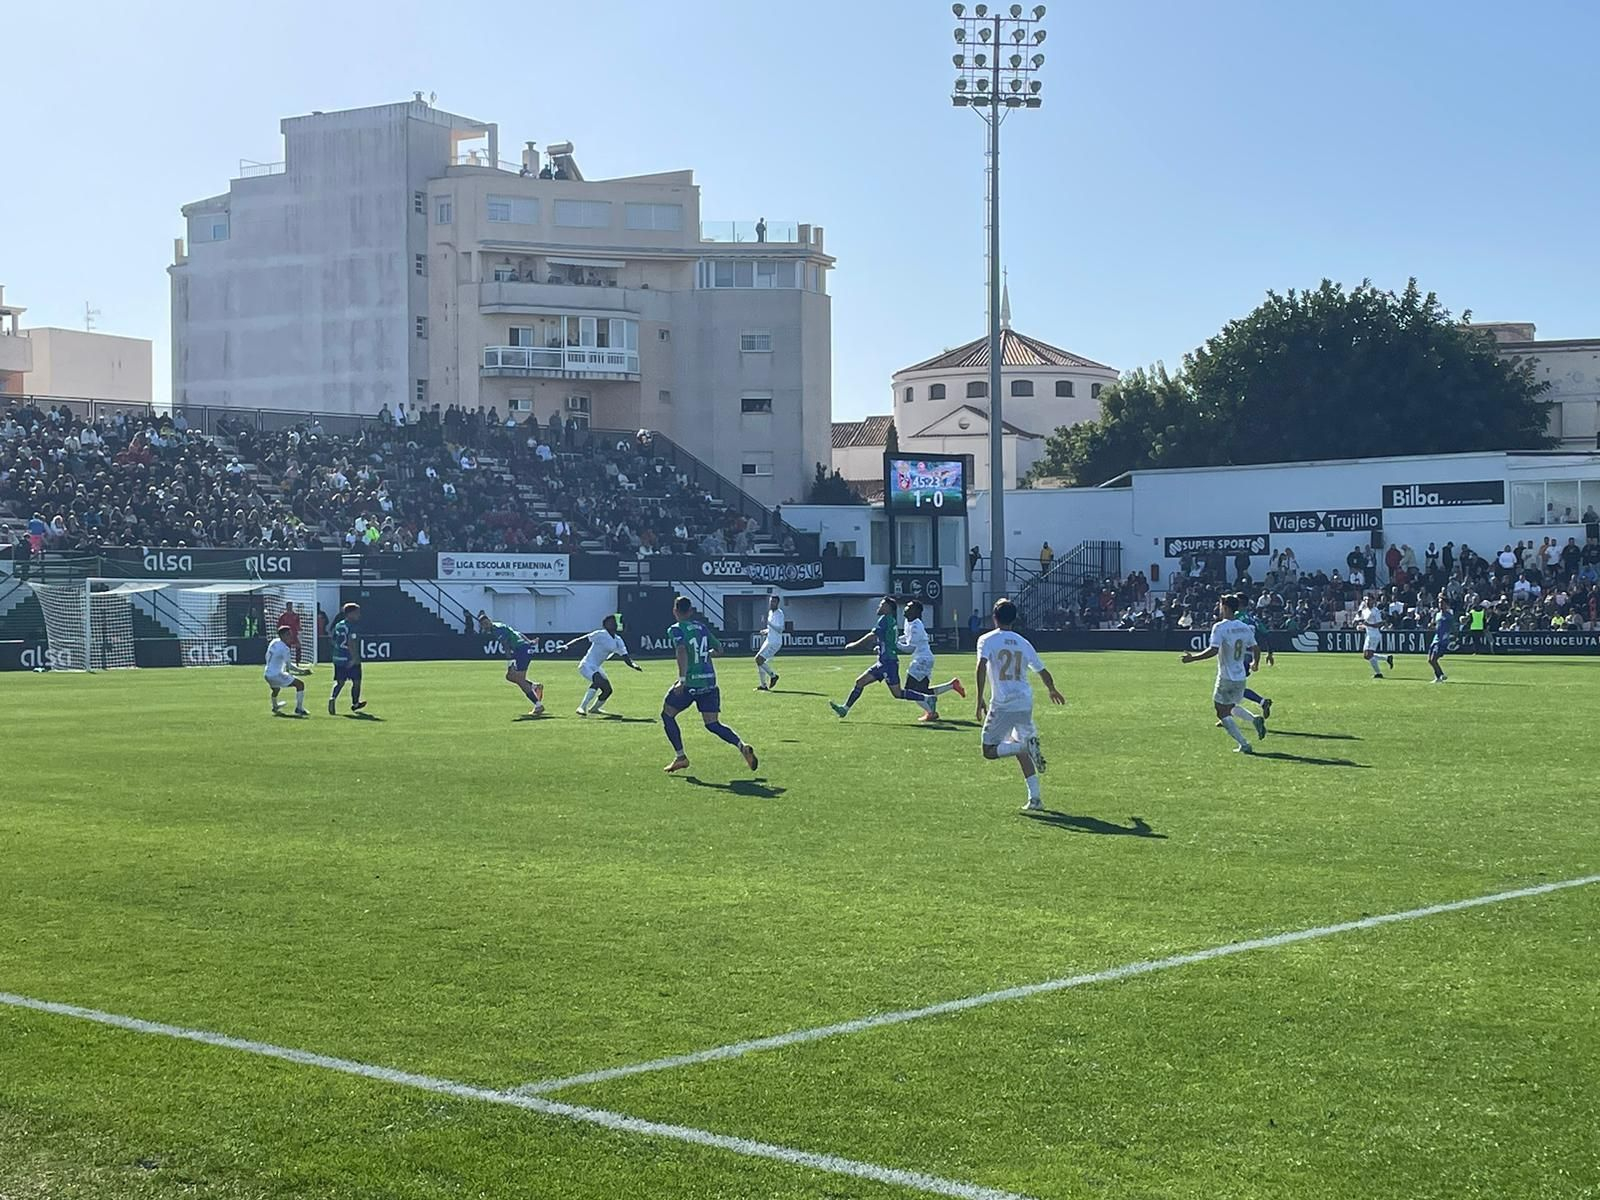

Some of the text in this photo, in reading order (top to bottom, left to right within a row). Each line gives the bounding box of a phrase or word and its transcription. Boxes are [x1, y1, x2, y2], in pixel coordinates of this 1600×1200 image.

[1273, 513, 1379, 532] Viajes Trujillo
[1183, 538, 1251, 550] SUPER SPORT
[144, 552, 192, 571] alsa
[246, 553, 291, 572] alsa
[456, 560, 552, 570] LIGA ESCOLAR FEMENINA
[189, 644, 238, 662] alsa
[360, 639, 391, 659] lsa
[689, 636, 709, 664] 14
[1234, 639, 1243, 660] 8
[997, 648, 1023, 681] 21
